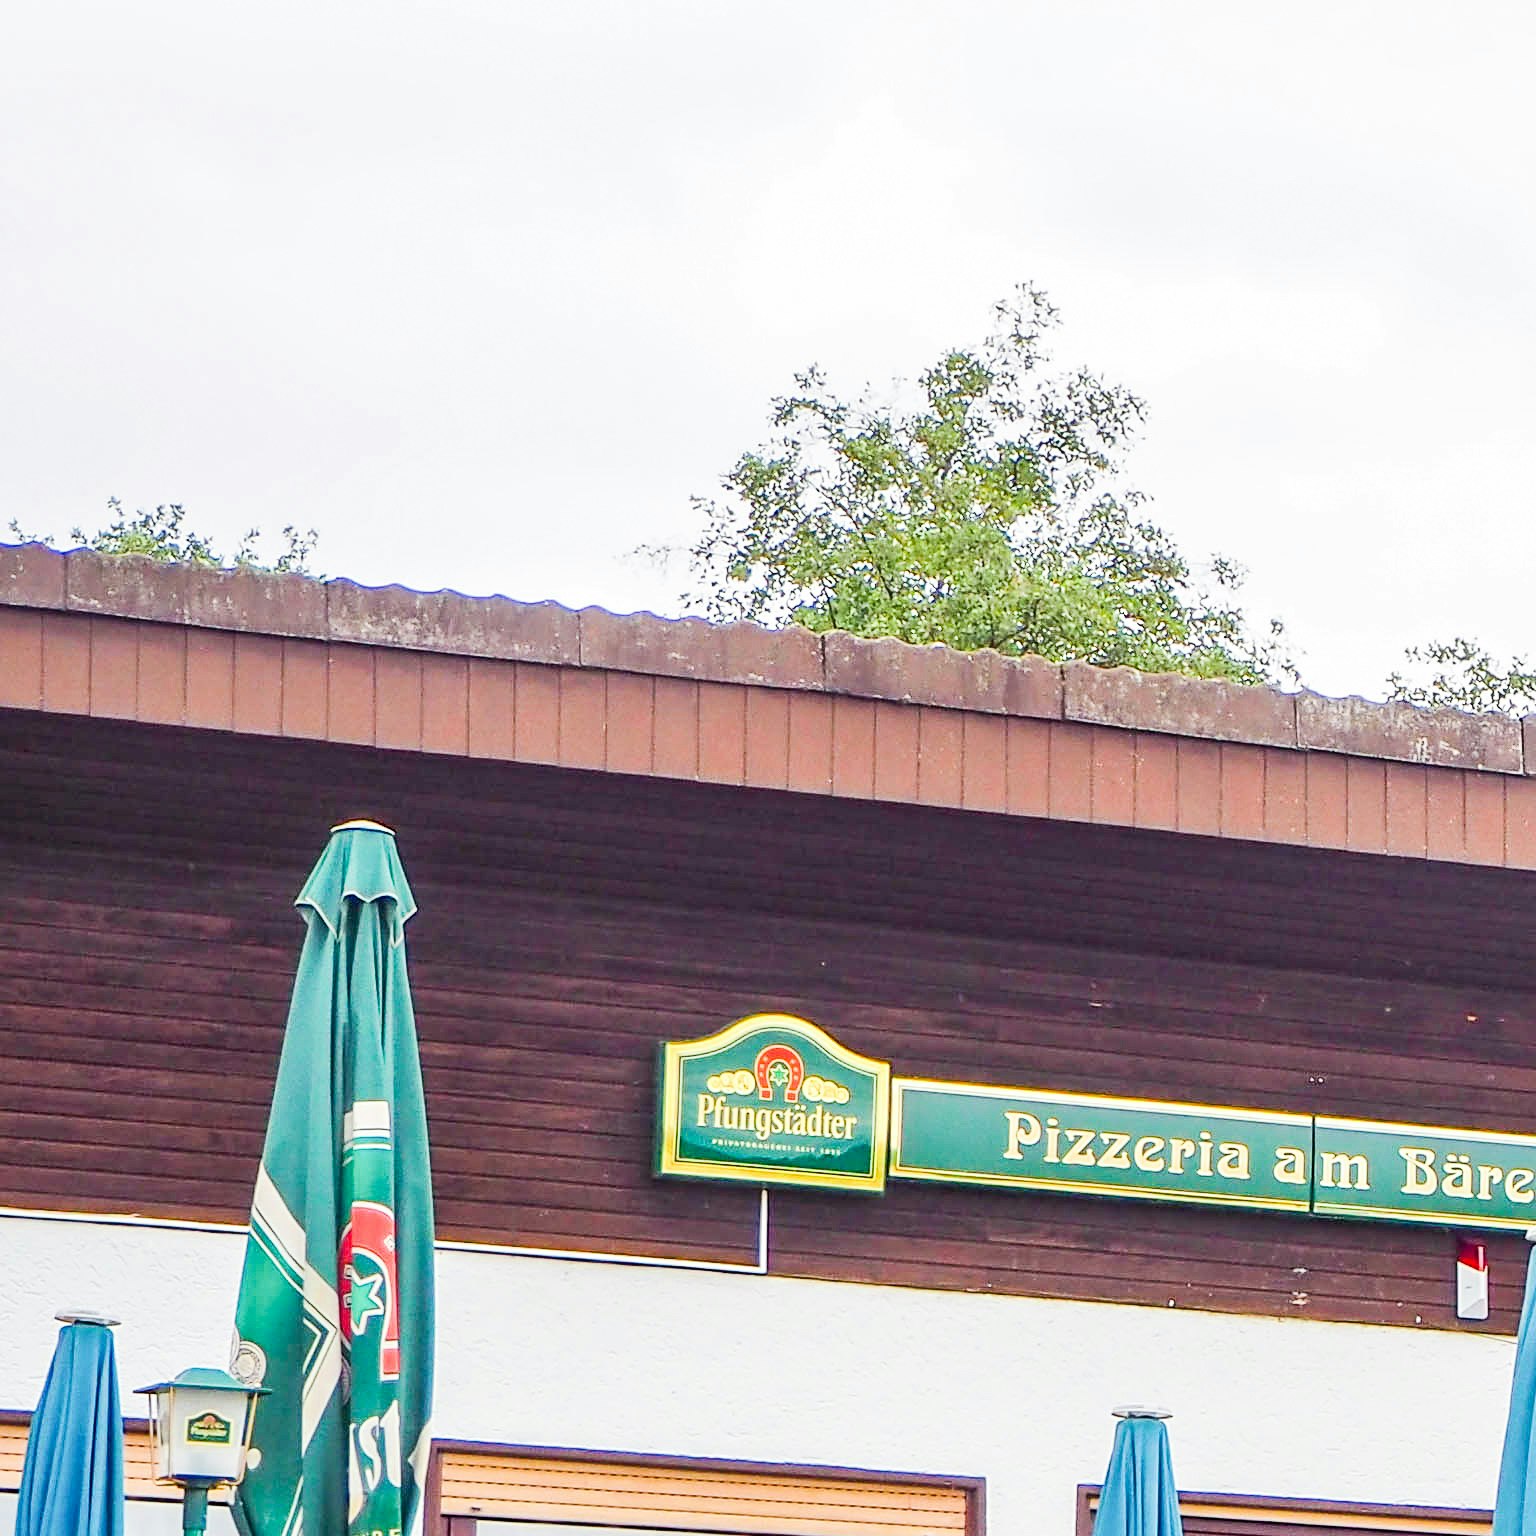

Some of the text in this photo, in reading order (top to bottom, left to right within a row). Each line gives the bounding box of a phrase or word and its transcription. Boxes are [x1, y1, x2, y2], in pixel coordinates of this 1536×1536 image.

[696, 1093, 858, 1141] Pfungstädter
[1002, 1110, 1251, 1180] Pizzeria
[1273, 1146, 1371, 1191] am
